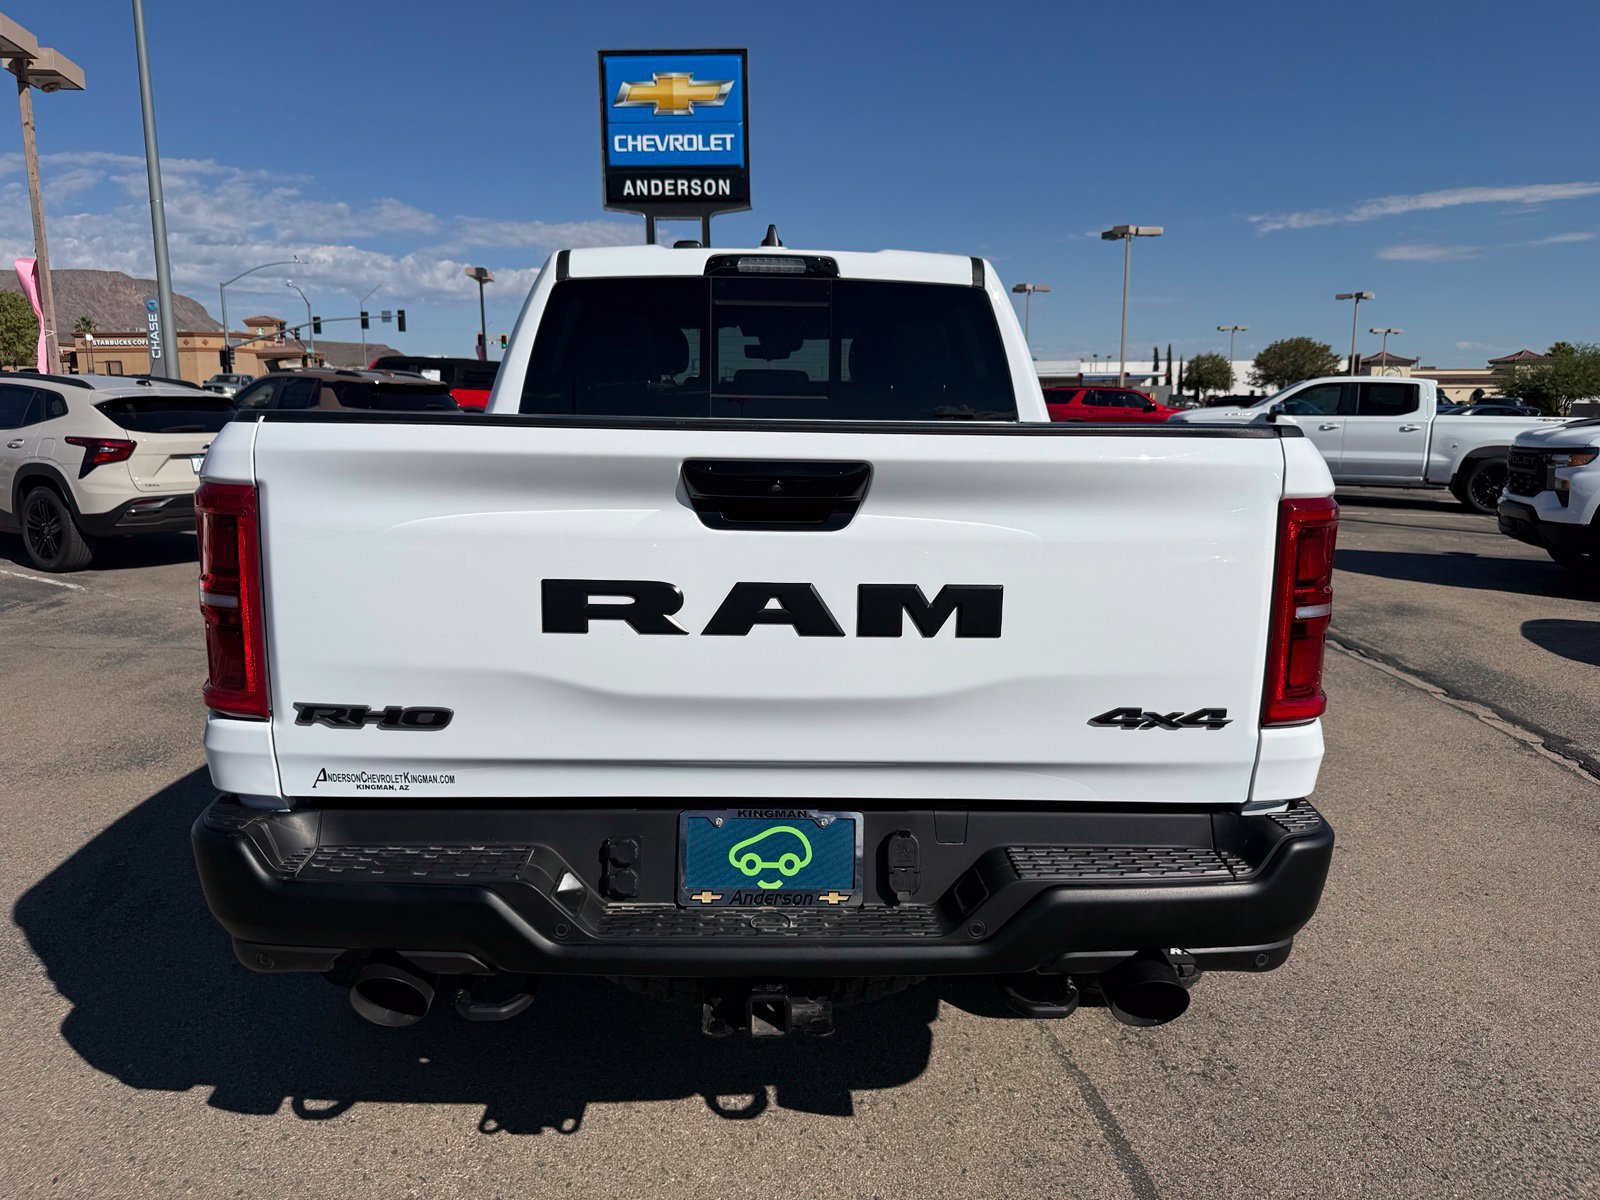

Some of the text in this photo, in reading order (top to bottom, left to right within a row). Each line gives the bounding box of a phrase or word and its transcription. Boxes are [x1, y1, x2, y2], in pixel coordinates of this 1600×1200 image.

[613, 133, 735, 152] CHEVROLET
[622, 178, 731, 196] ANDERSON
[148, 313, 161, 359] CHASE
[541, 578, 1004, 639] RAM
[293, 702, 454, 731] RHO
[737, 809, 807, 818] KINGMAN
[729, 890, 813, 905] Anderson
